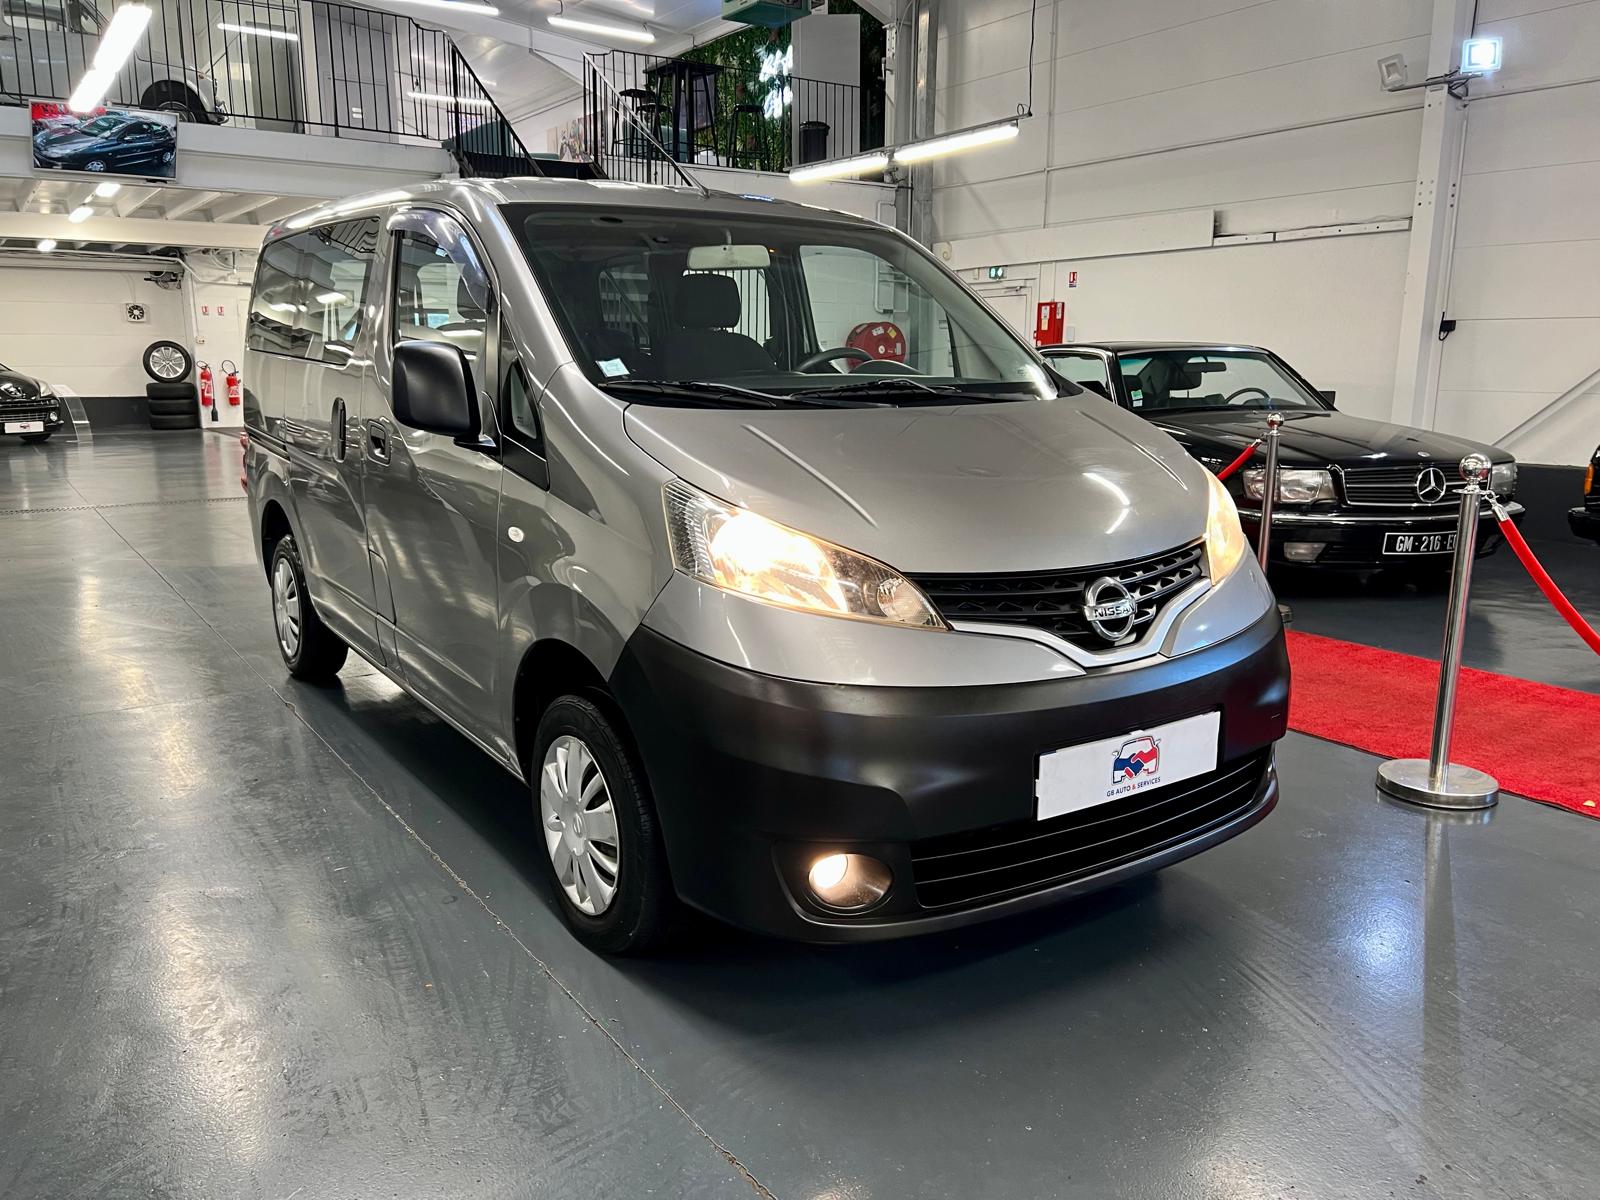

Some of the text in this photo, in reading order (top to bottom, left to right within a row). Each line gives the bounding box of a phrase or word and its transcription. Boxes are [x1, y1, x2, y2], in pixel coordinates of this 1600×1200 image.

[1094, 604, 1135, 618] NISSAN
[1106, 789, 1115, 797] GB
[1116, 785, 1131, 795] AUTO
[1137, 776, 1161, 789] SERVICES
